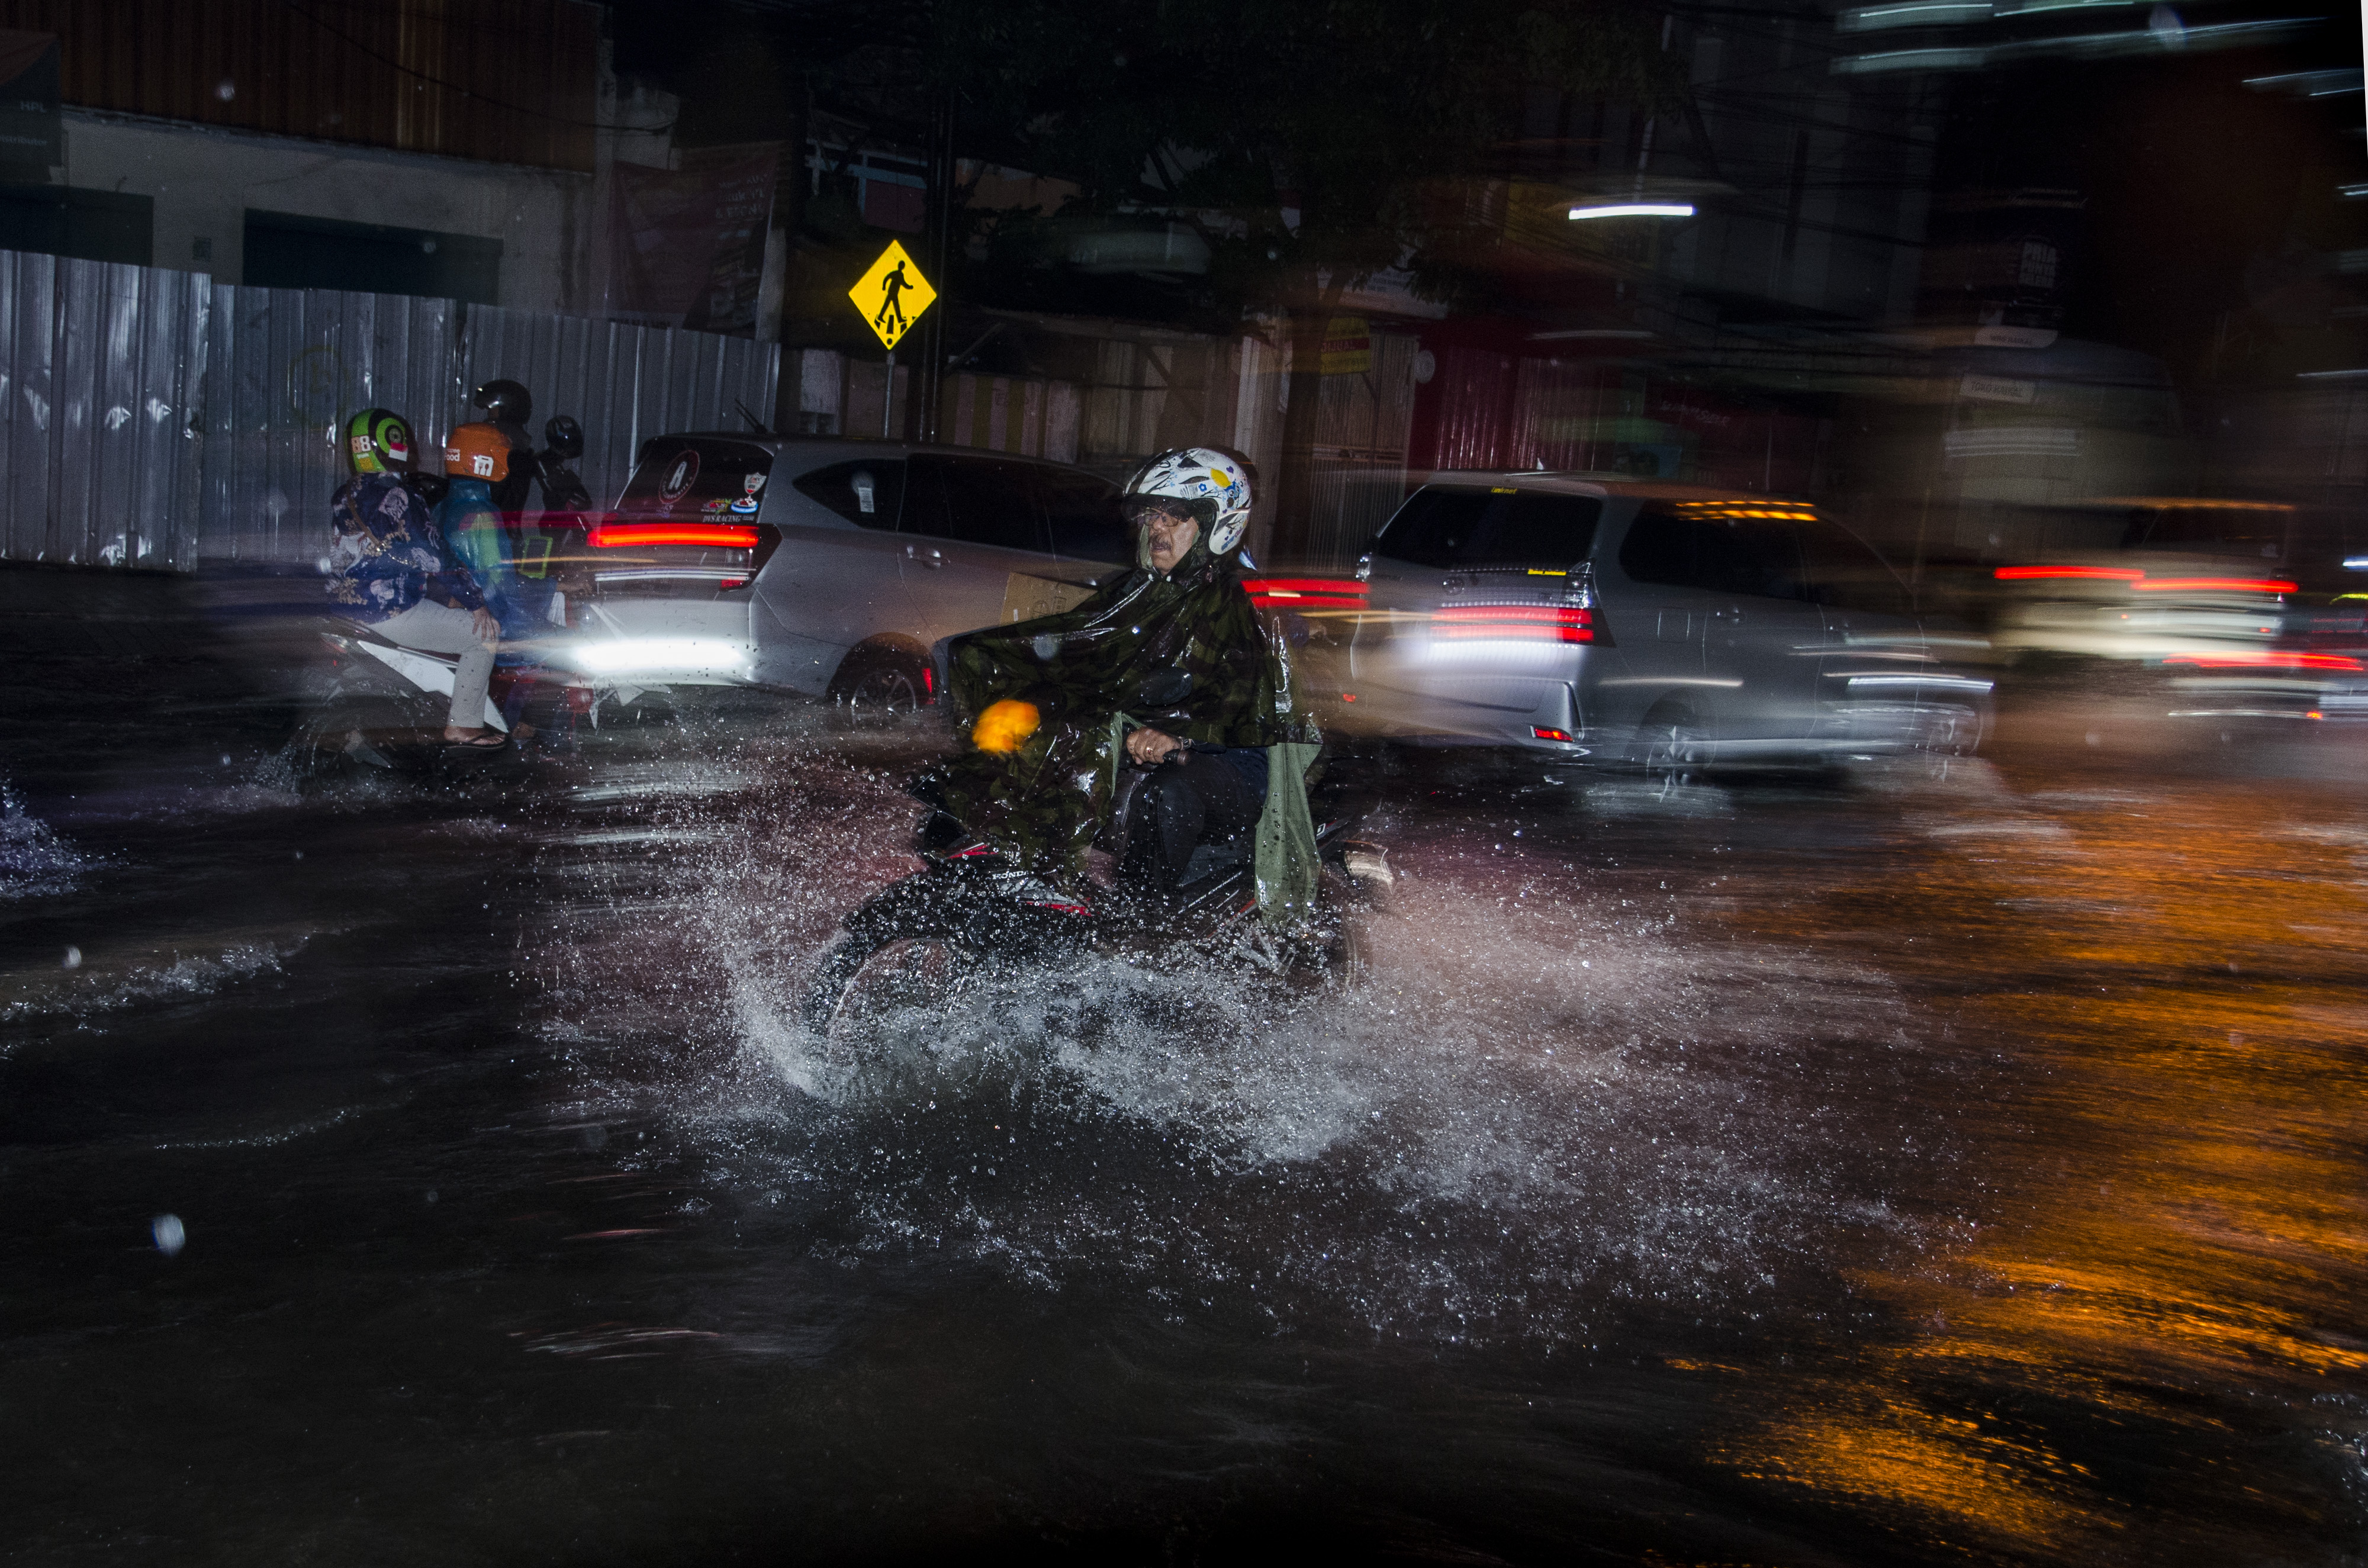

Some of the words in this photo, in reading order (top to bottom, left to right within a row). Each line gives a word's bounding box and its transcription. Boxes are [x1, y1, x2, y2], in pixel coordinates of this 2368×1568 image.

[20, 101, 47, 113] HPL
[351, 434, 371, 453] 88
[716, 514, 742, 523] RACING
